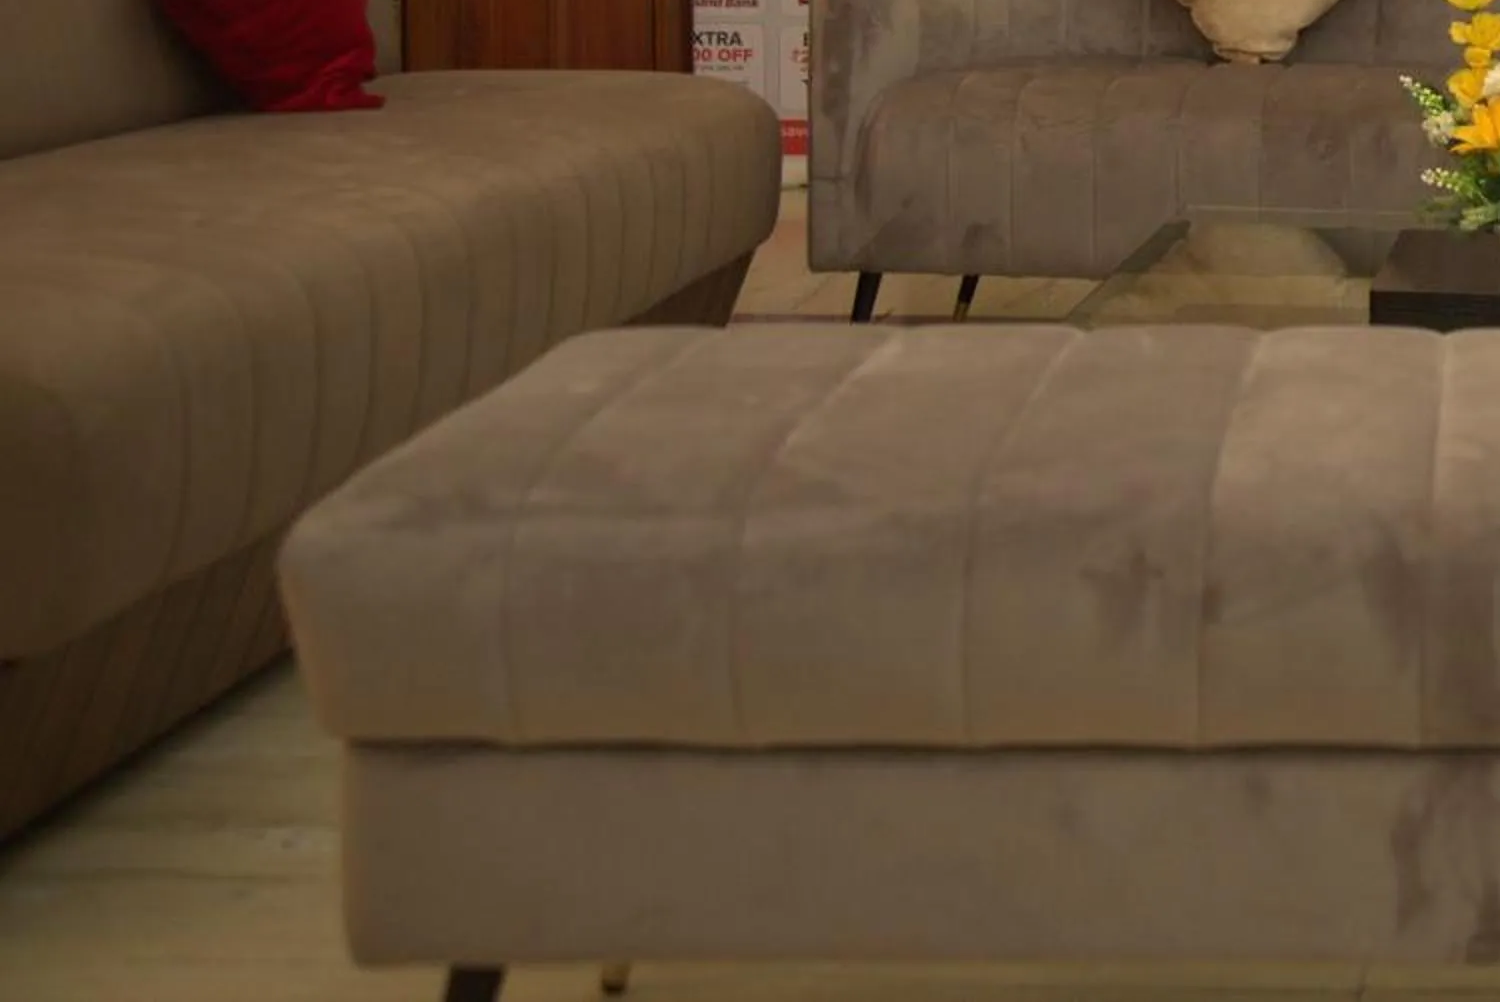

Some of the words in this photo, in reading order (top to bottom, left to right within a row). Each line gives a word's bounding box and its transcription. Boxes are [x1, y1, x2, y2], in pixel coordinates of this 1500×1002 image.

[689, 31, 743, 47] XTRA
[692, 48, 712, 62] 00
[718, 48, 753, 63] OFF
